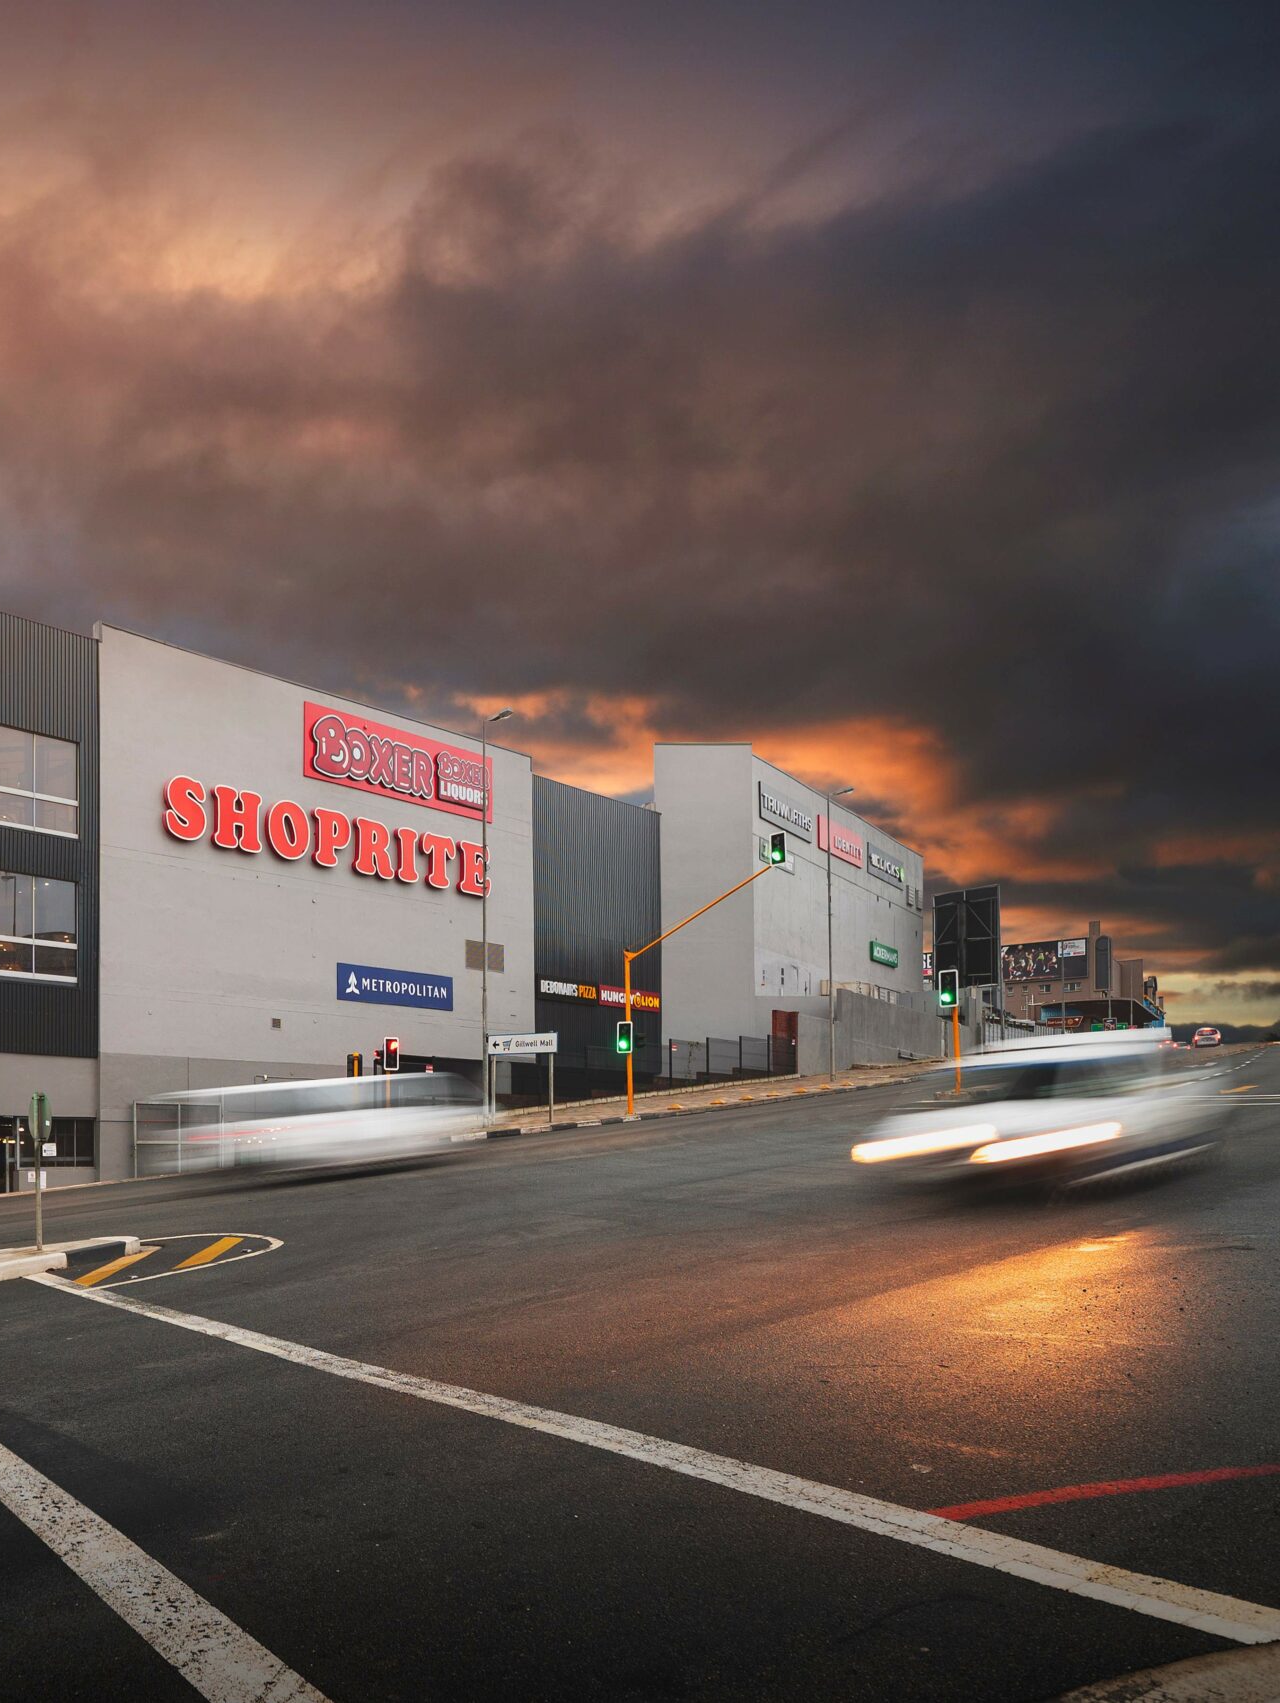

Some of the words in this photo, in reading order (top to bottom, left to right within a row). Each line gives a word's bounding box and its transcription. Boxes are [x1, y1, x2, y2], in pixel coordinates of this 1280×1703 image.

[312, 714, 434, 799] BOXER
[437, 751, 490, 790] BOXER
[440, 780, 489, 806] LIQUORS
[162, 775, 492, 898] SHOPRITE
[833, 835, 863, 860] IDENTITY
[361, 977, 448, 999] METROPOLITAN
[540, 979, 579, 998] DEBONAIRS
[579, 984, 597, 1000] PIZZA
[601, 989, 634, 1005] HUNGY
[641, 996, 660, 1009] LION
[514, 1040, 538, 1048] Gillwell
[540, 1039, 553, 1047] Mall
